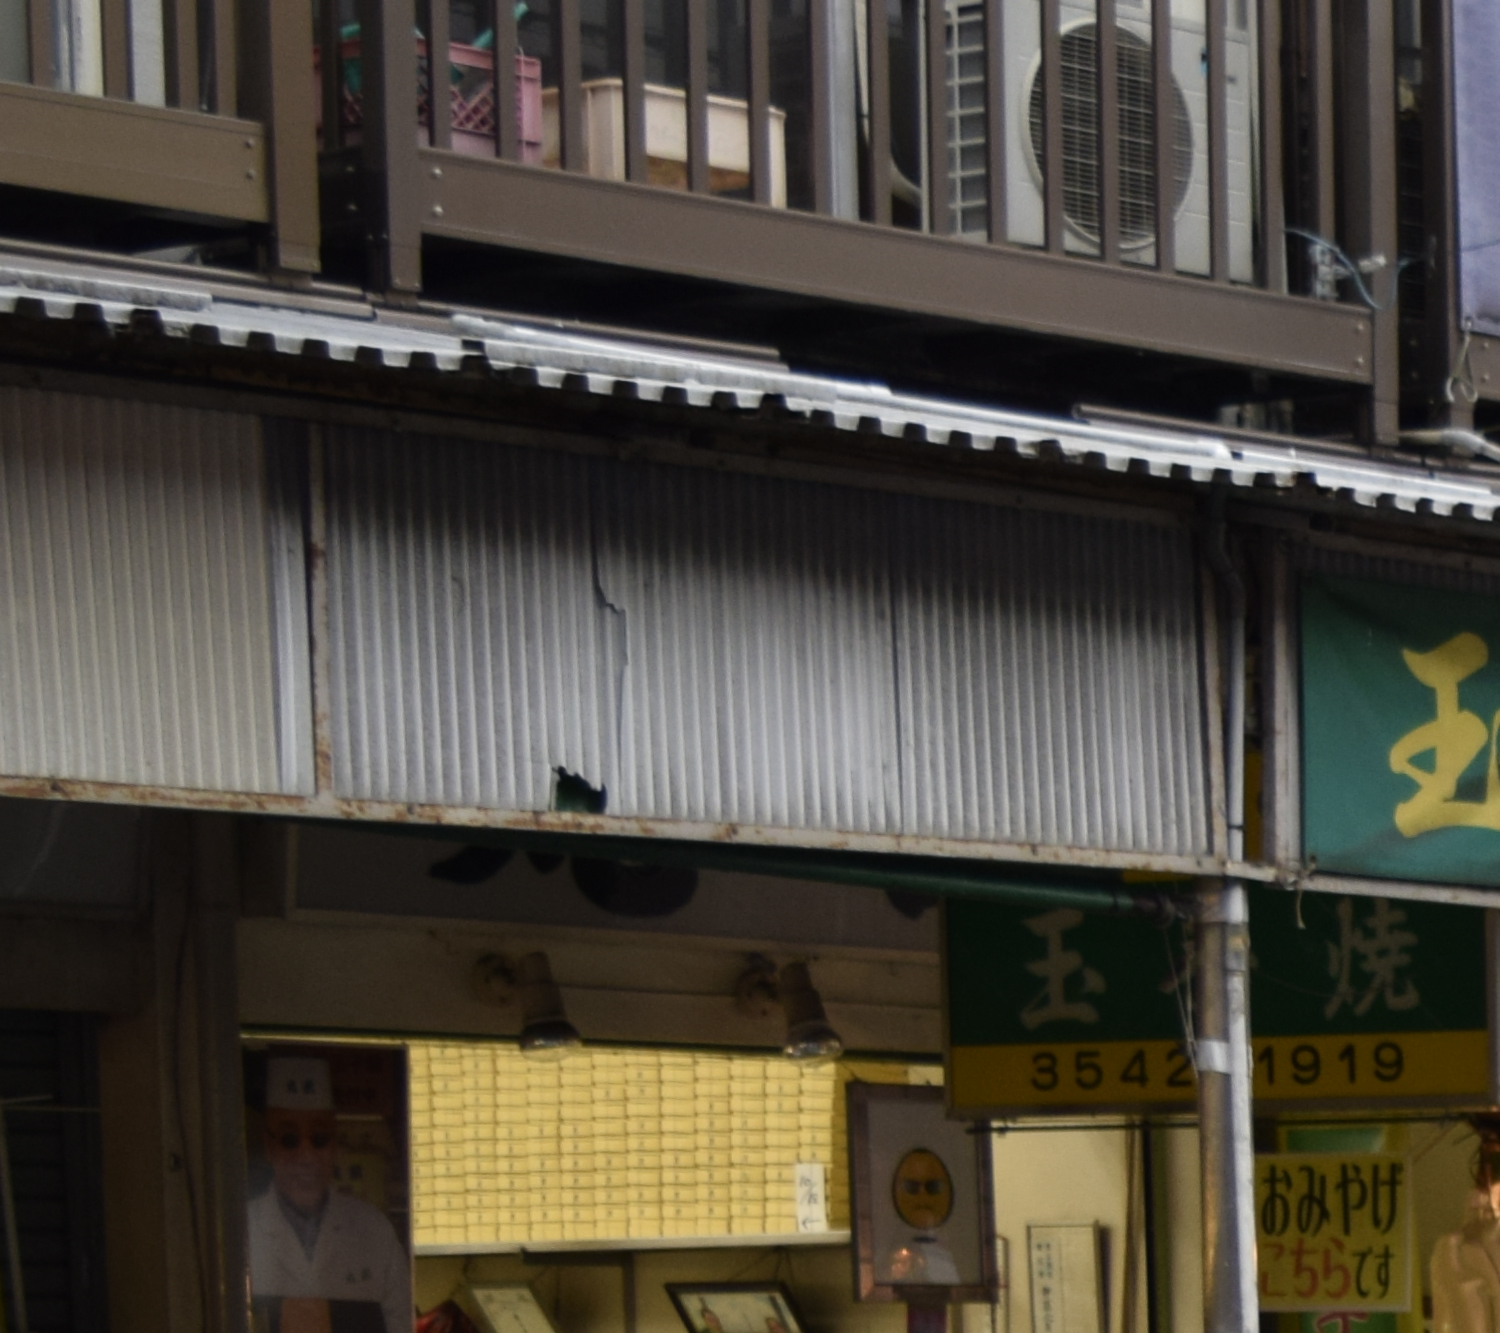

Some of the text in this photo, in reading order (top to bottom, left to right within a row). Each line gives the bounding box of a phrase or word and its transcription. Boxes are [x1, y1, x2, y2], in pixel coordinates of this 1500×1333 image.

[1020, 898, 1422, 1030] 玉焼
[1030, 1041, 1407, 1091] 3542 1919
[1261, 1163, 1404, 1237] おみやげ
[1260, 1238, 1396, 1301] こちらです
